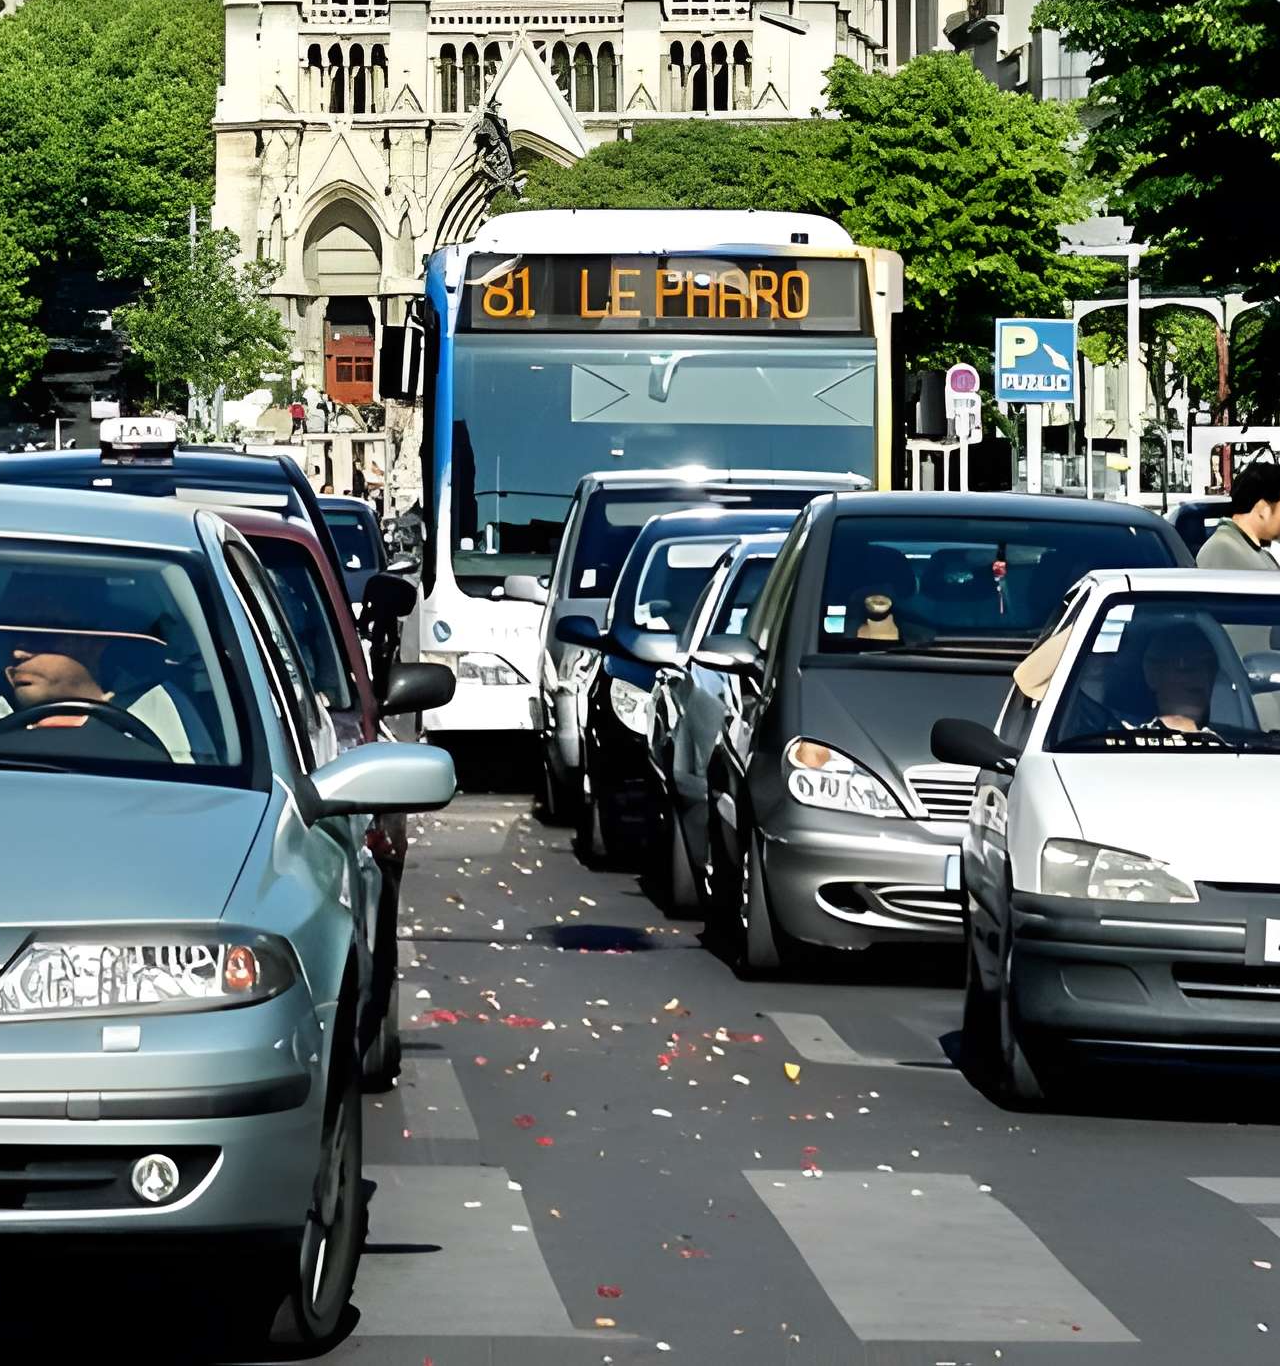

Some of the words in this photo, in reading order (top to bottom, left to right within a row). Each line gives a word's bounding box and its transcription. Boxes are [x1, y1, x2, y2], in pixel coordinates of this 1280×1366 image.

[580, 268, 641, 318] LE
[656, 268, 810, 321] PHARO
[1001, 325, 1039, 369] P
